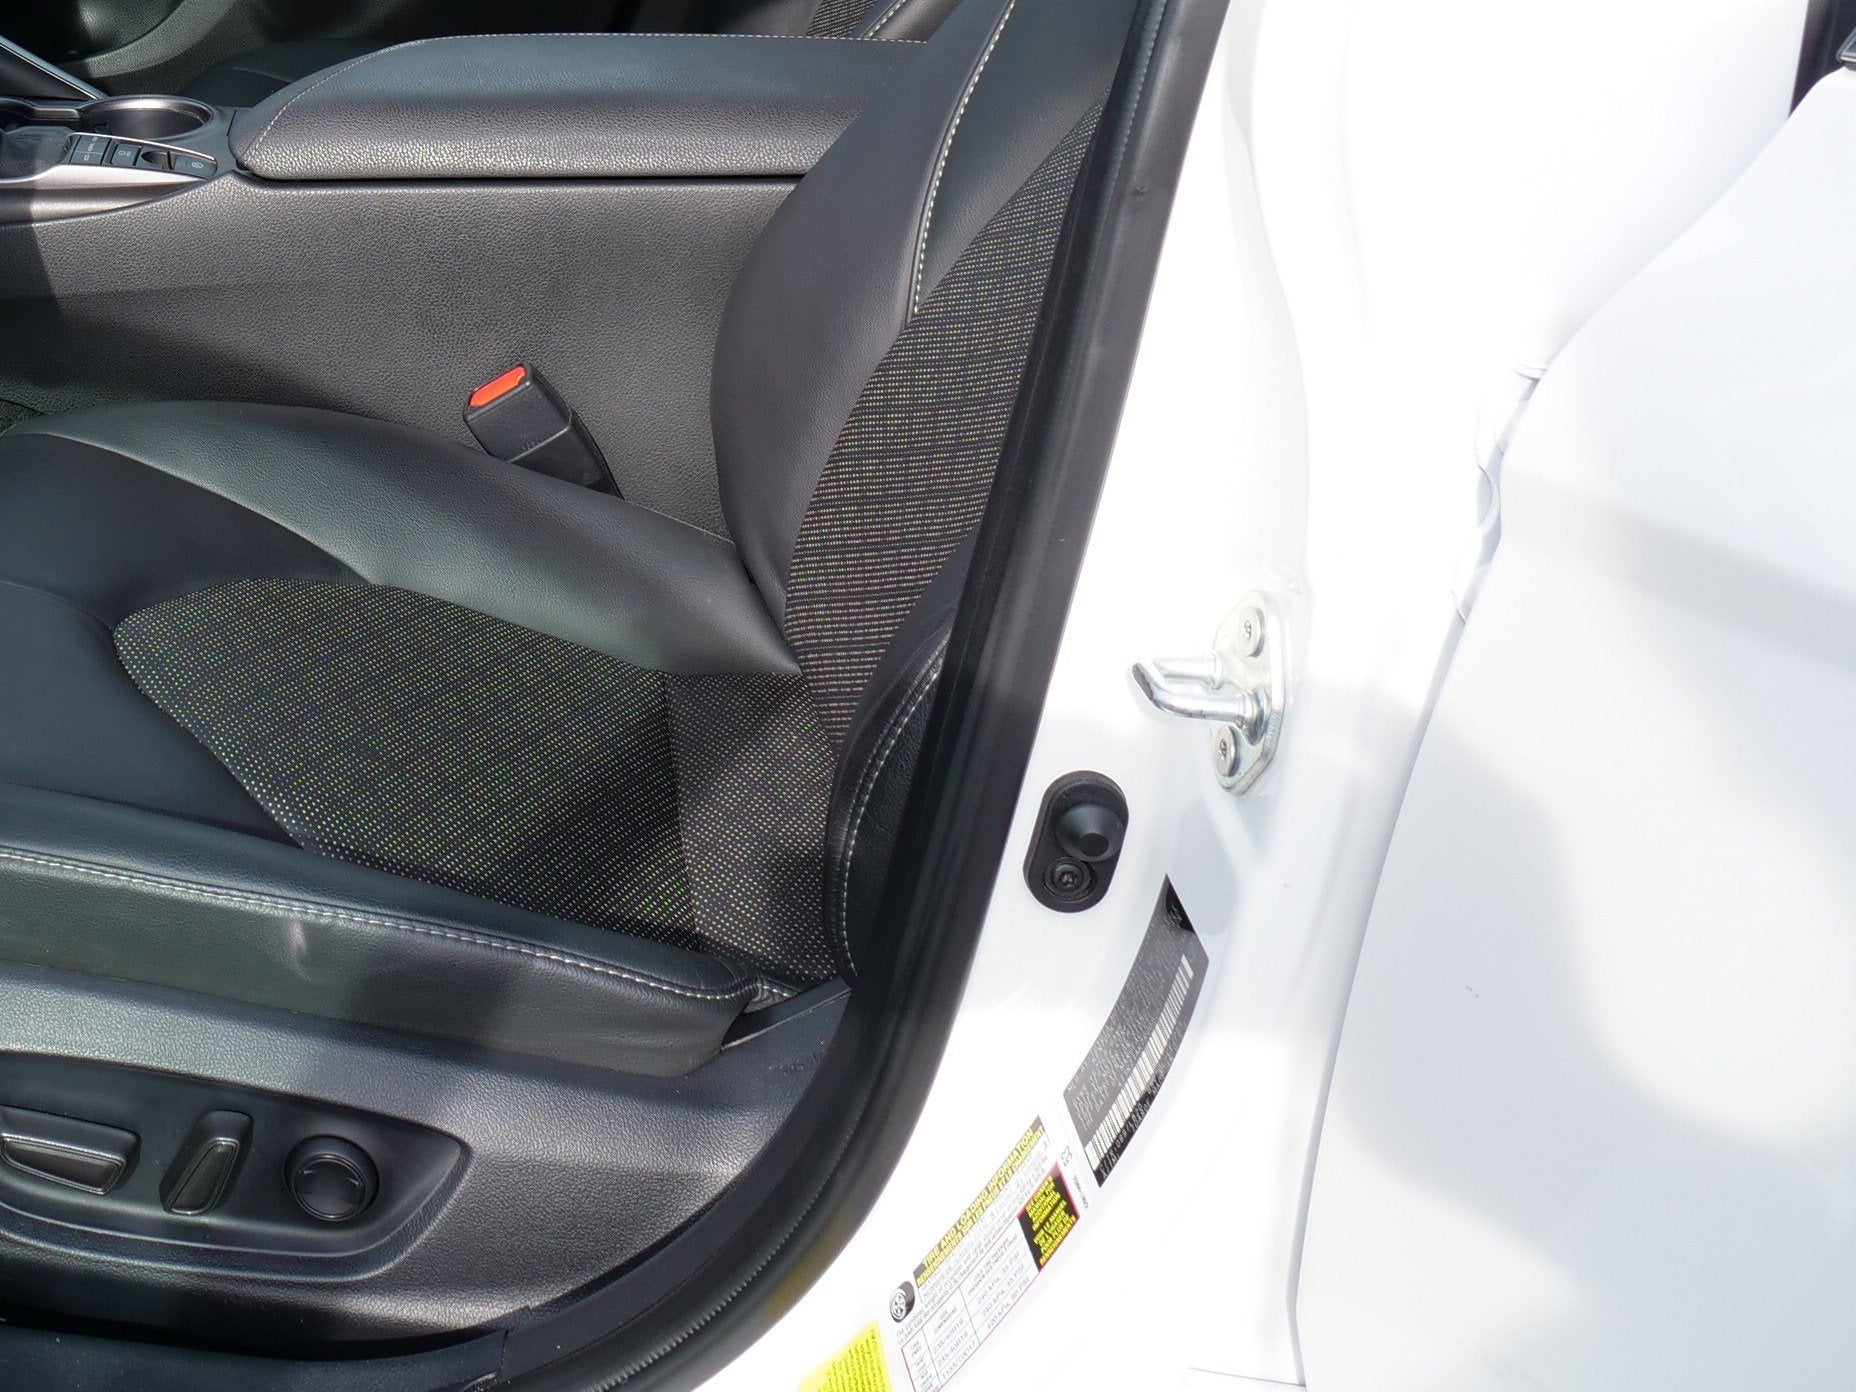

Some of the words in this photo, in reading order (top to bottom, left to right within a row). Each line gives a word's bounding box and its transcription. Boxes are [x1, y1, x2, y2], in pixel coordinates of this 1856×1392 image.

[922, 1245, 940, 1268] TIRE
[939, 1225, 956, 1250] AND
[955, 1187, 988, 1231] LOADING
[986, 1126, 1034, 1192] INFORMATION
